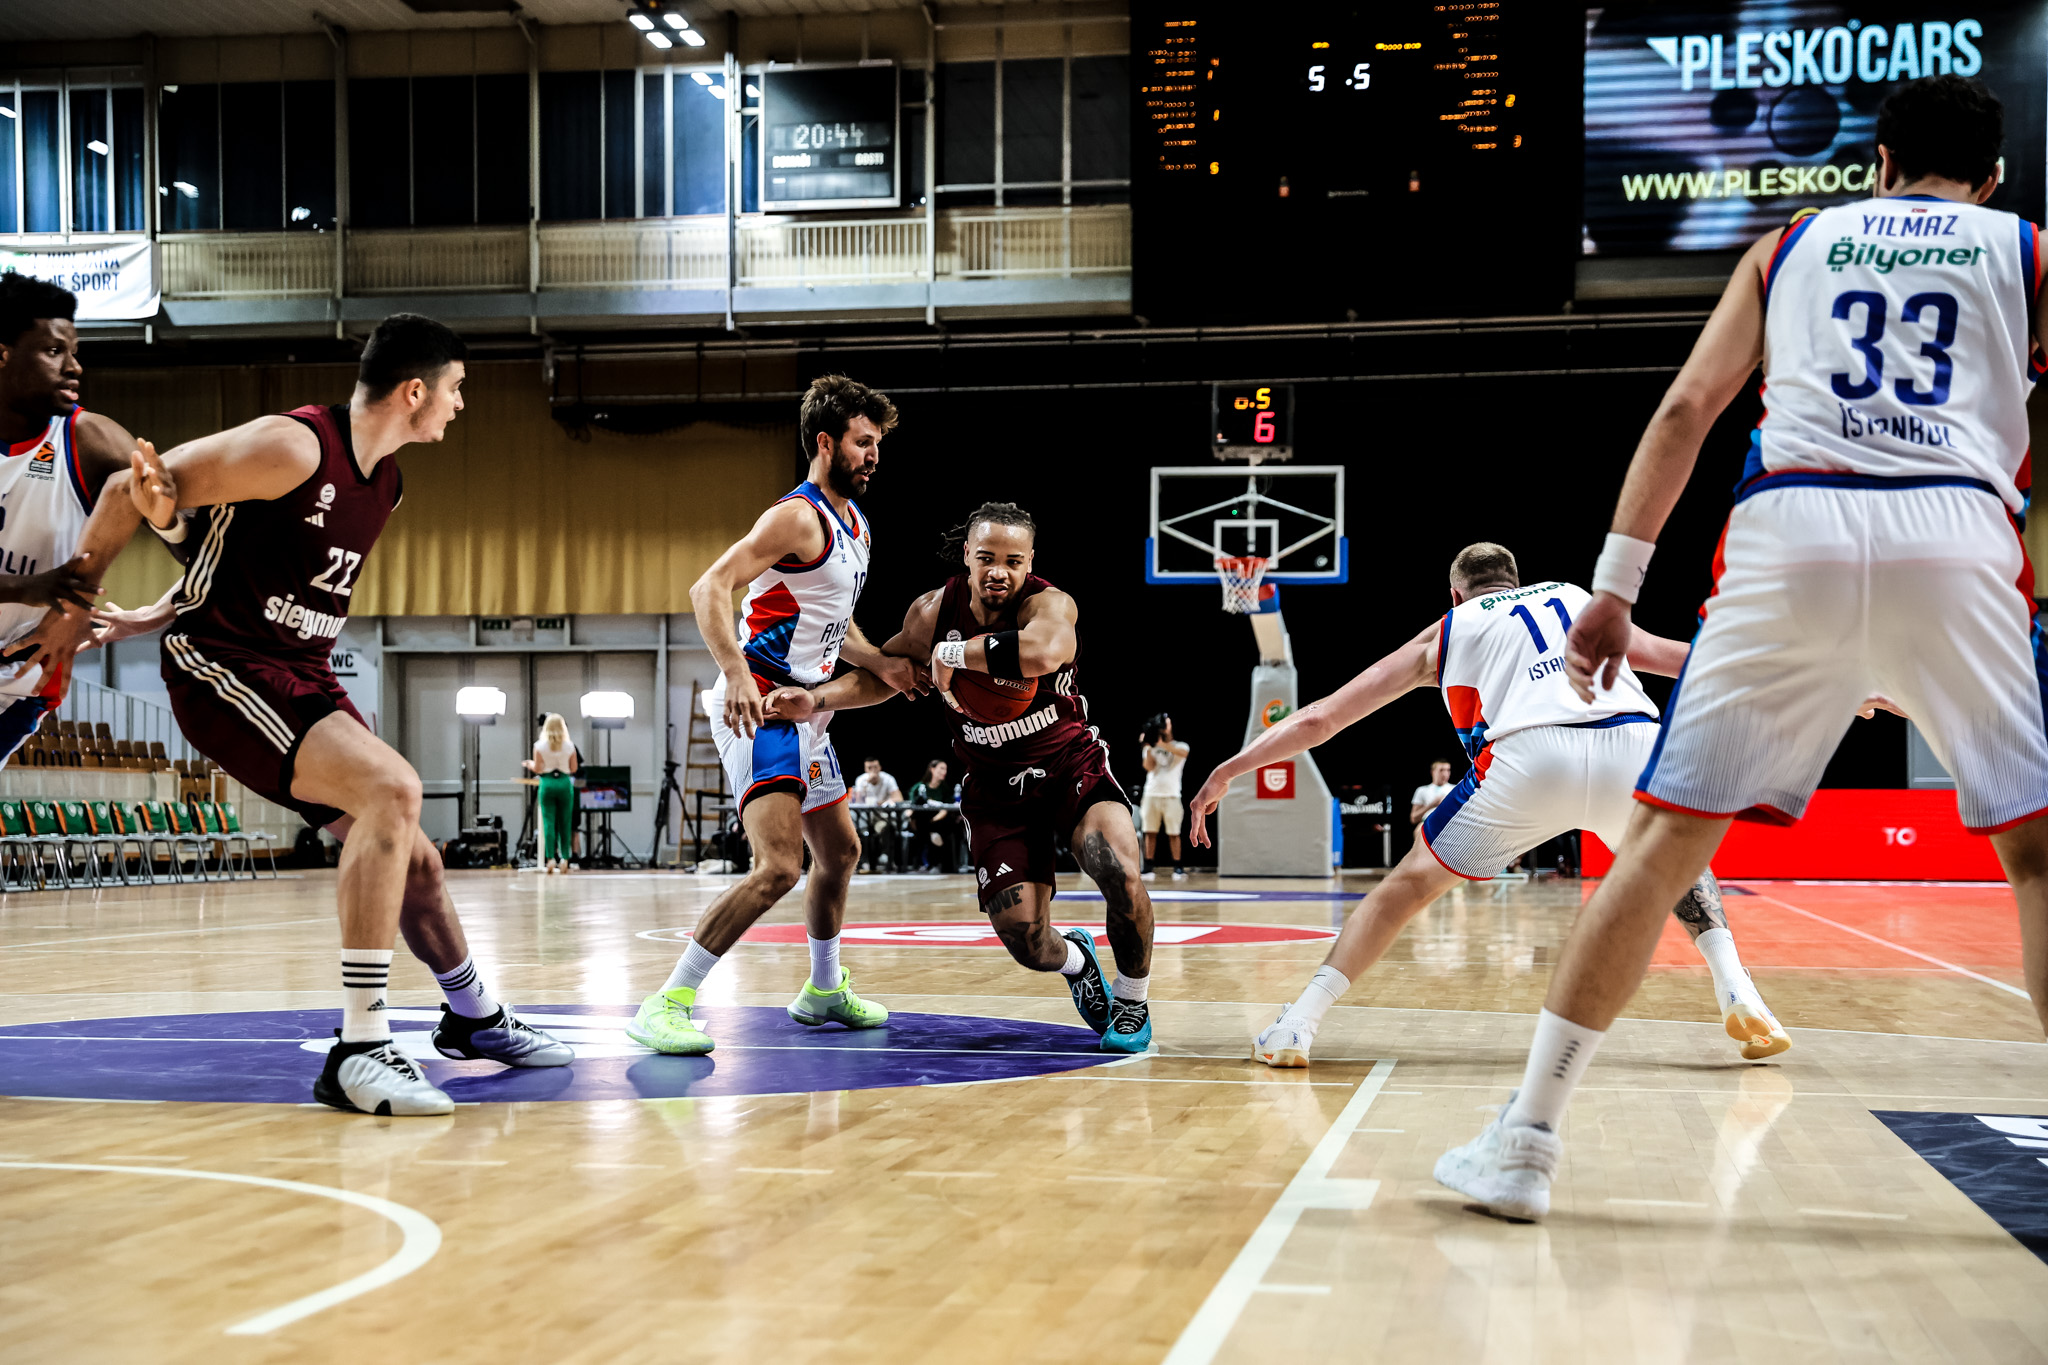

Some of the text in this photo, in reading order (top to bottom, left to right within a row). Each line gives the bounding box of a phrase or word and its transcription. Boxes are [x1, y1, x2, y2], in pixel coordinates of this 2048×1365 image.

[793, 122, 864, 150] 20:44
[1621, 162, 1878, 202] WWW.PLESKOCA
[1862, 214, 1959, 237] YILMAZ
[1826, 236, 1988, 275] Bilyoner
[71, 271, 121, 292] ŠPORT
[1830, 288, 1960, 407] 33
[1253, 410, 1276, 444] 6
[309, 546, 363, 597] 22
[264, 593, 348, 640] siegmu
[820, 617, 849, 644] ANA
[1508, 597, 1574, 655] 11
[331, 653, 355, 669] WC
[1528, 655, 1568, 682] İSTAN
[962, 703, 1060, 749] siegmund
